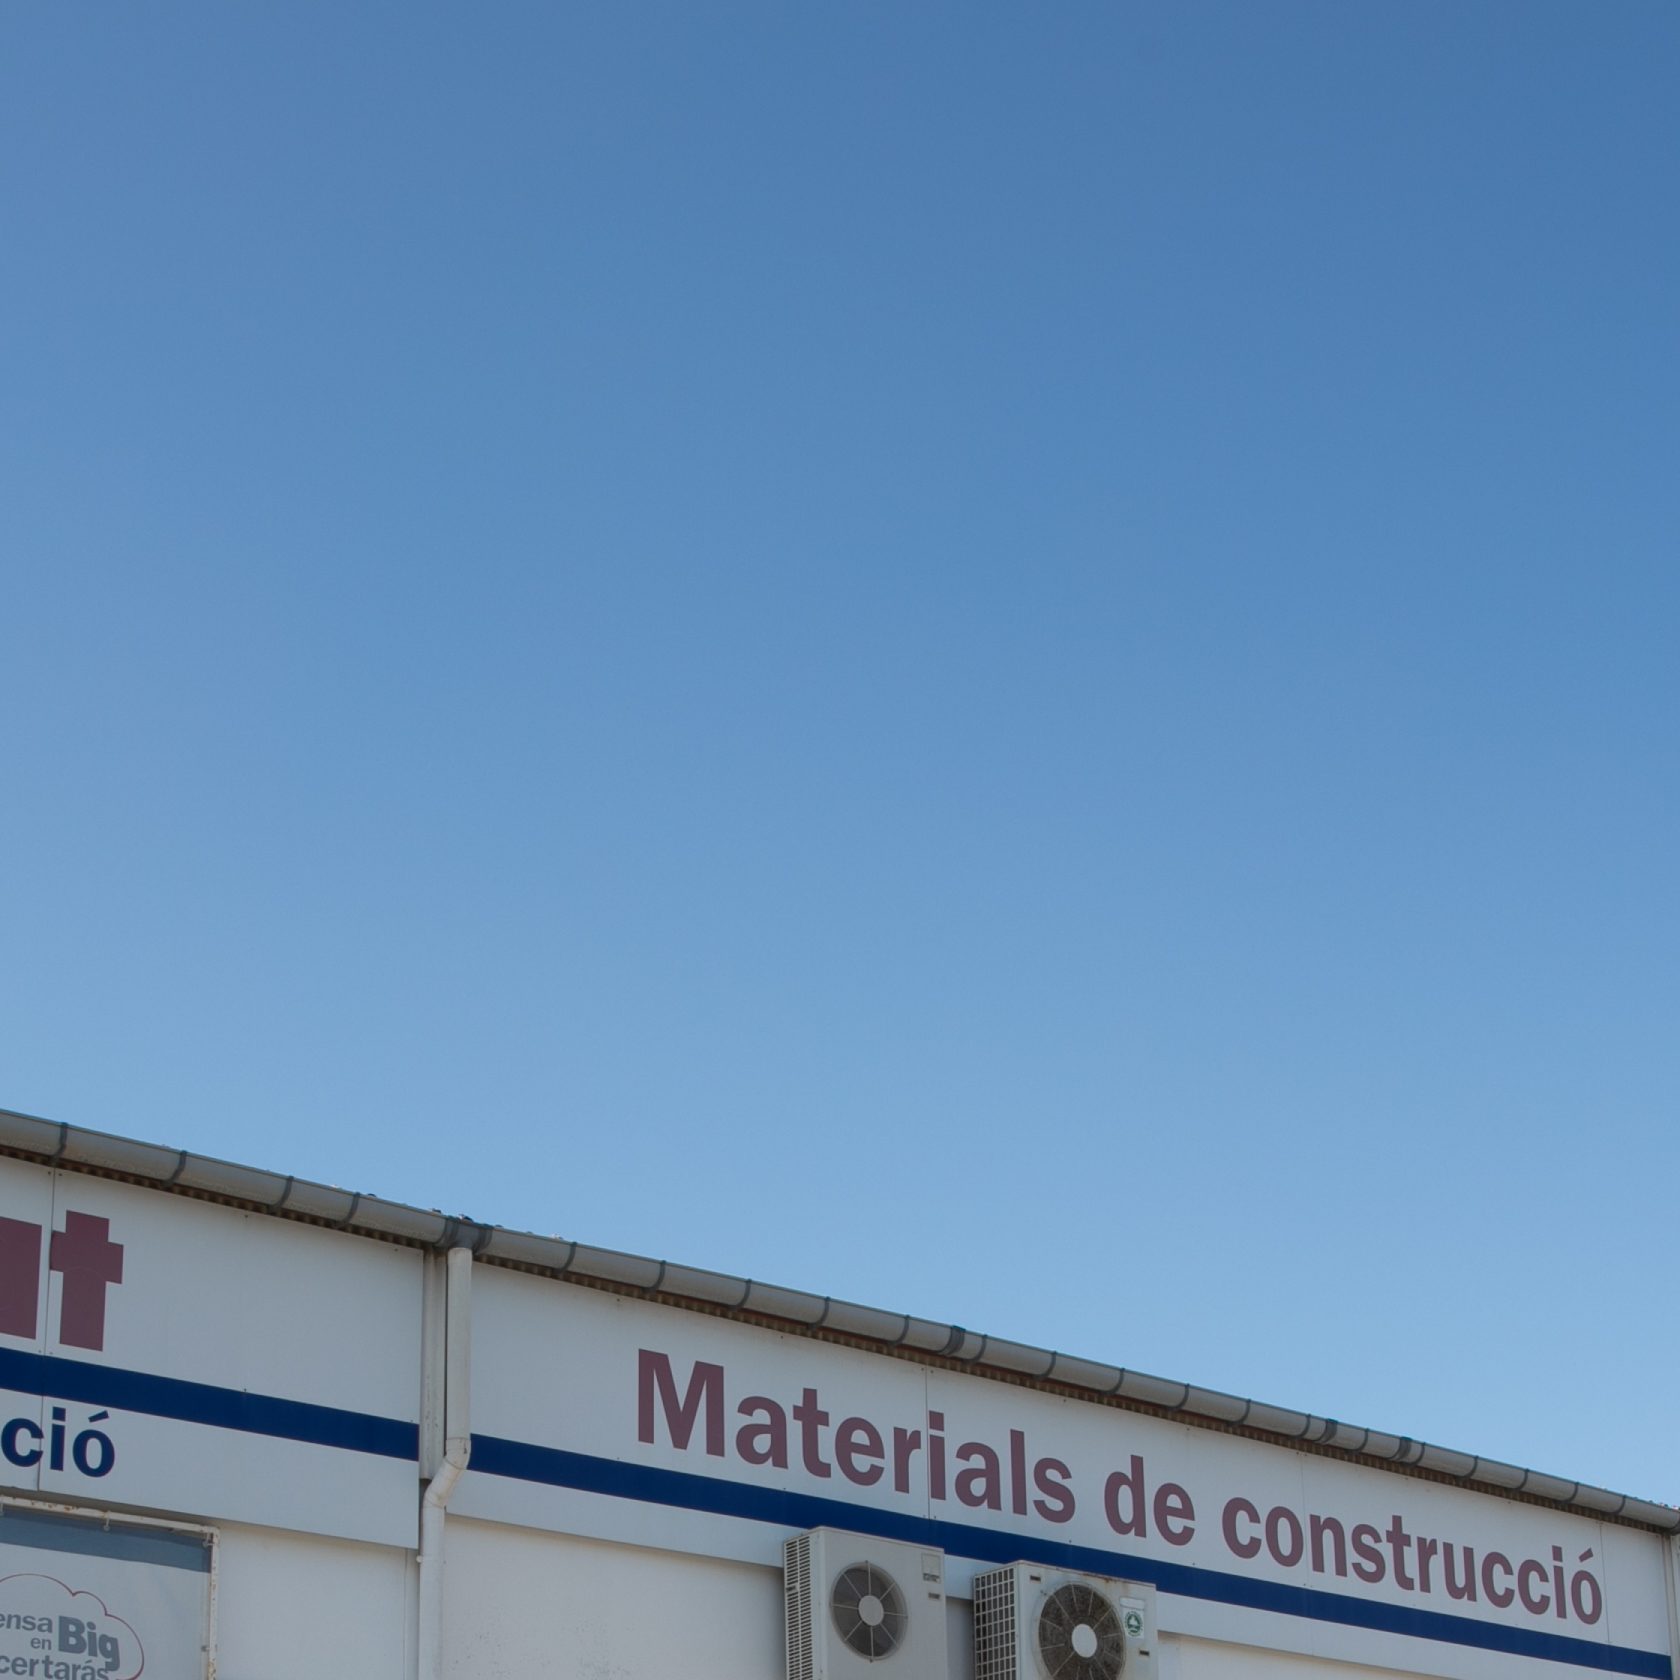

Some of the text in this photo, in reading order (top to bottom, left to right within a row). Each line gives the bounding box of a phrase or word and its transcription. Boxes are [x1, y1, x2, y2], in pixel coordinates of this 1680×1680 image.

[636, 1347, 1604, 1626] Materials de construcció
[30, 1633, 53, 1651] en
[56, 1614, 122, 1672] Big
